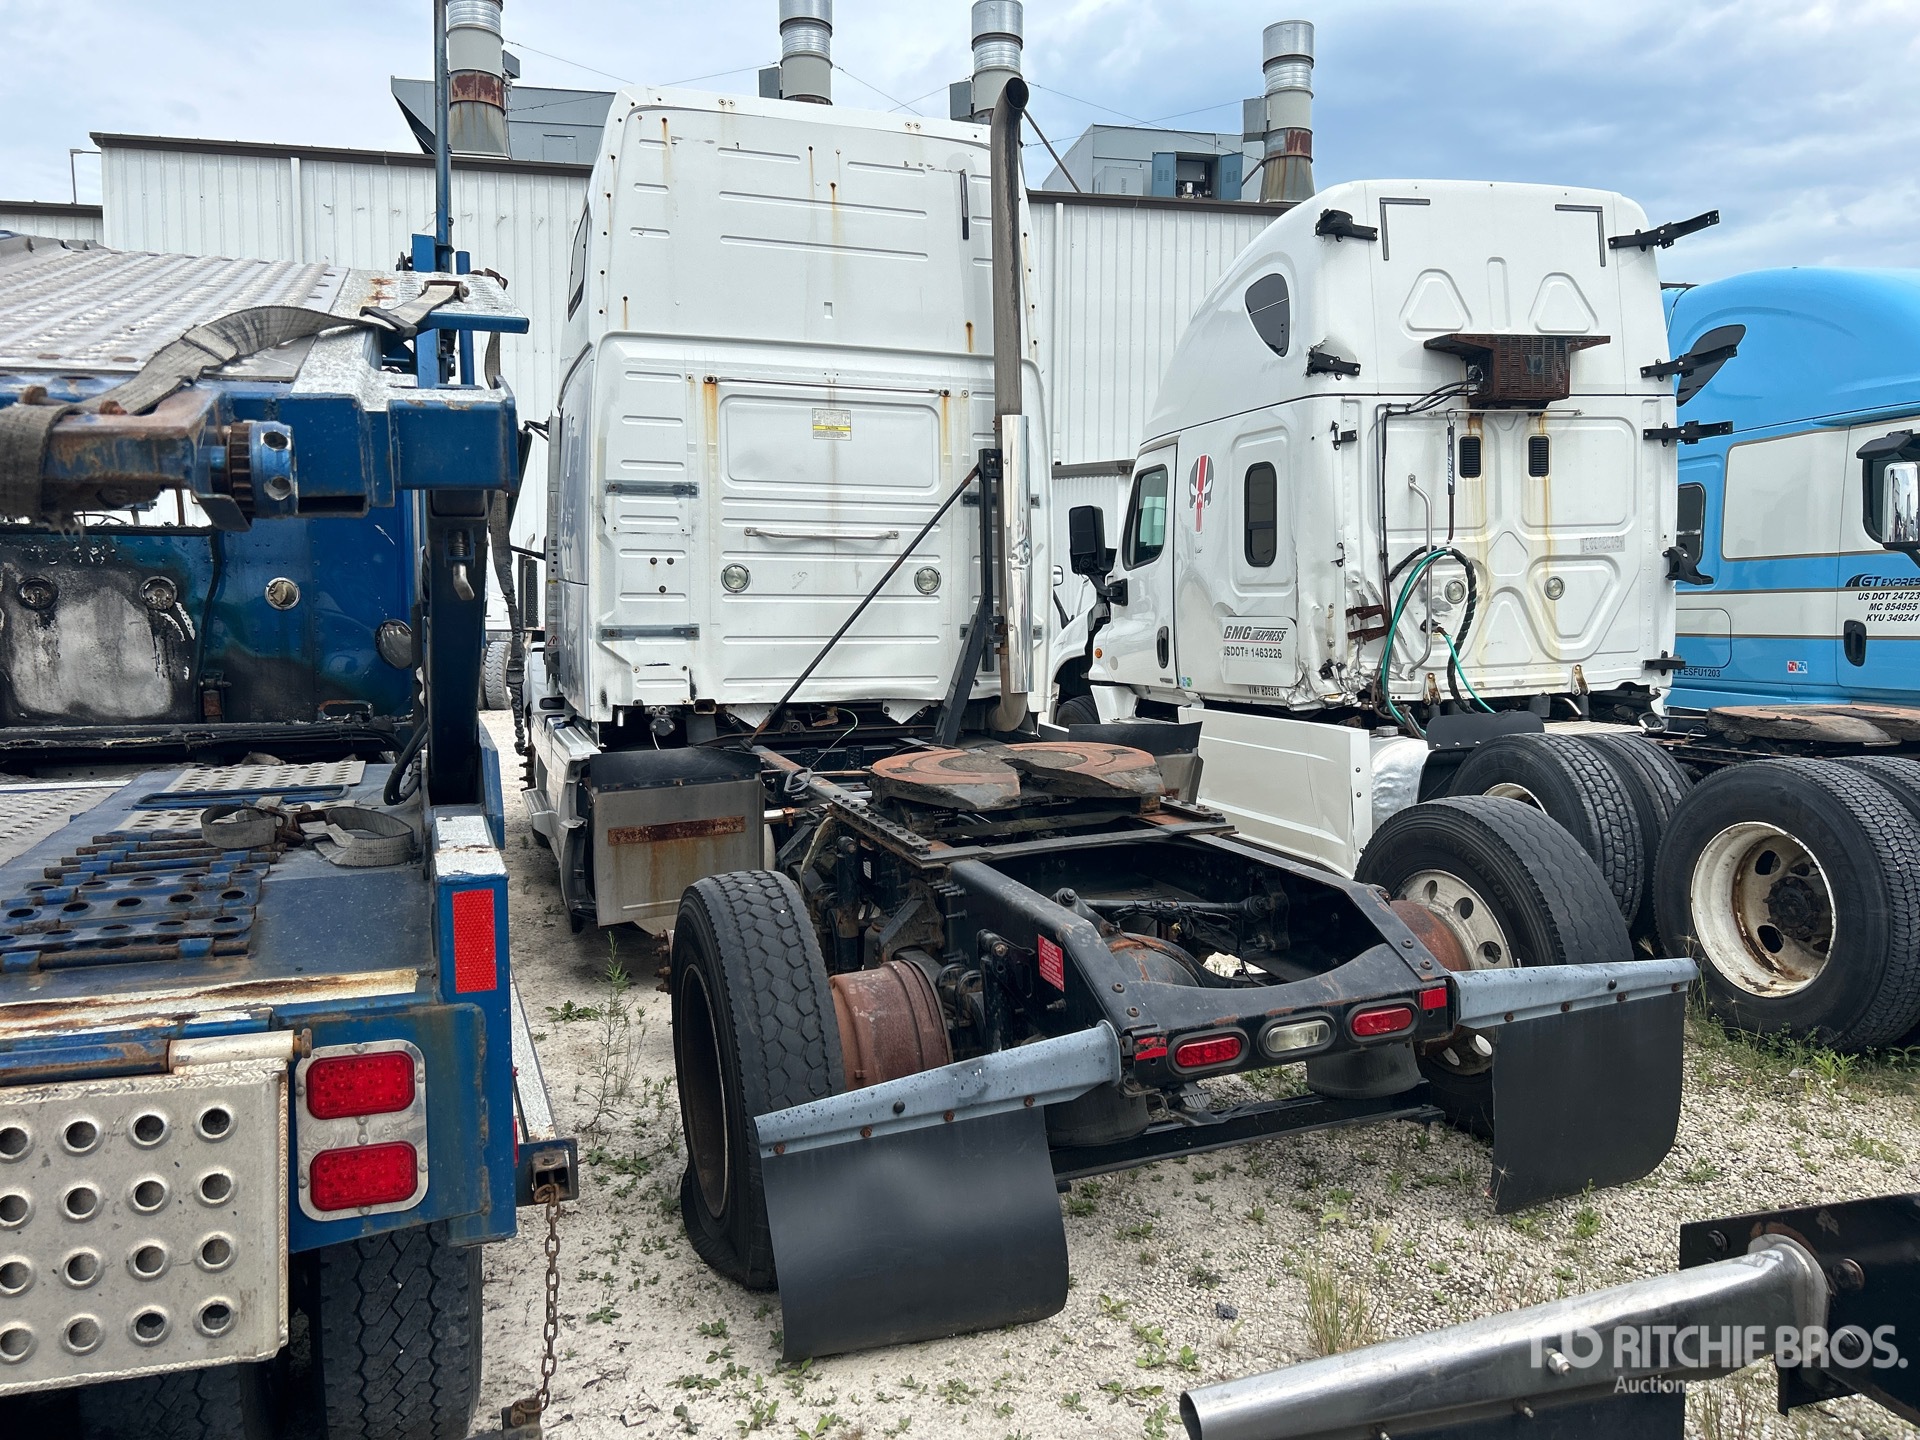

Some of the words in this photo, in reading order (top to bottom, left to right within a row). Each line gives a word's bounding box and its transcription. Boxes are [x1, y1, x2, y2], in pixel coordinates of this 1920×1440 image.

[1861, 576, 1881, 587] GT
[1858, 592, 1870, 600] US
[1872, 592, 1891, 600] DOT
[1892, 592, 1920, 600] 24723
[1869, 603, 1883, 611] MC
[1885, 603, 1918, 611] 854955
[1866, 614, 1886, 622] KYU
[1887, 614, 1920, 622] 349241
[1223, 625, 1252, 640] GMG
[1256, 630, 1287, 642] EXPRESS
[1251, 648, 1283, 659] 1463226
[1684, 668, 1720, 677] ESFU1203
